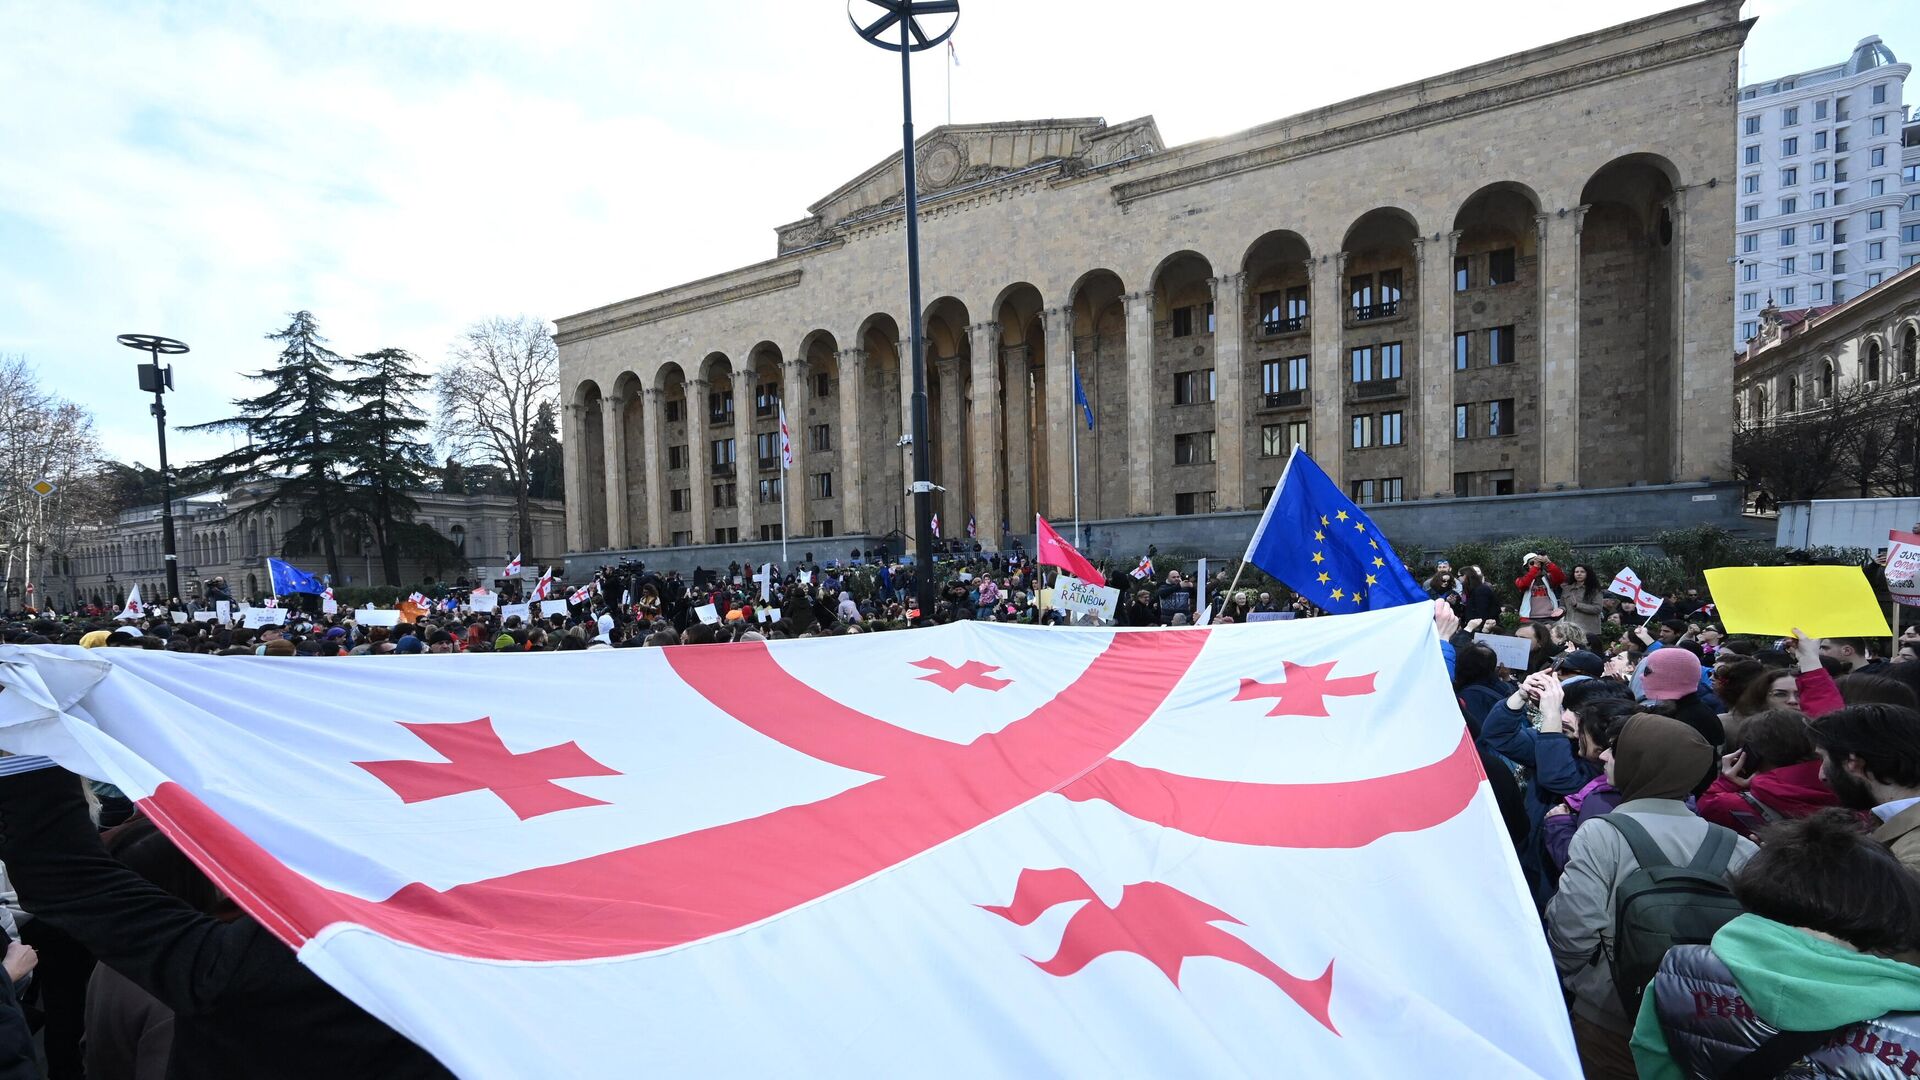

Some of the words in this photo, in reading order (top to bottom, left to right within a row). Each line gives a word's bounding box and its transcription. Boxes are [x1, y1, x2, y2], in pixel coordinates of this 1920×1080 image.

[1061, 590, 1107, 607] RAINBOW
[1089, 587, 1095, 595] A
[1692, 991, 1754, 1019] Pea
